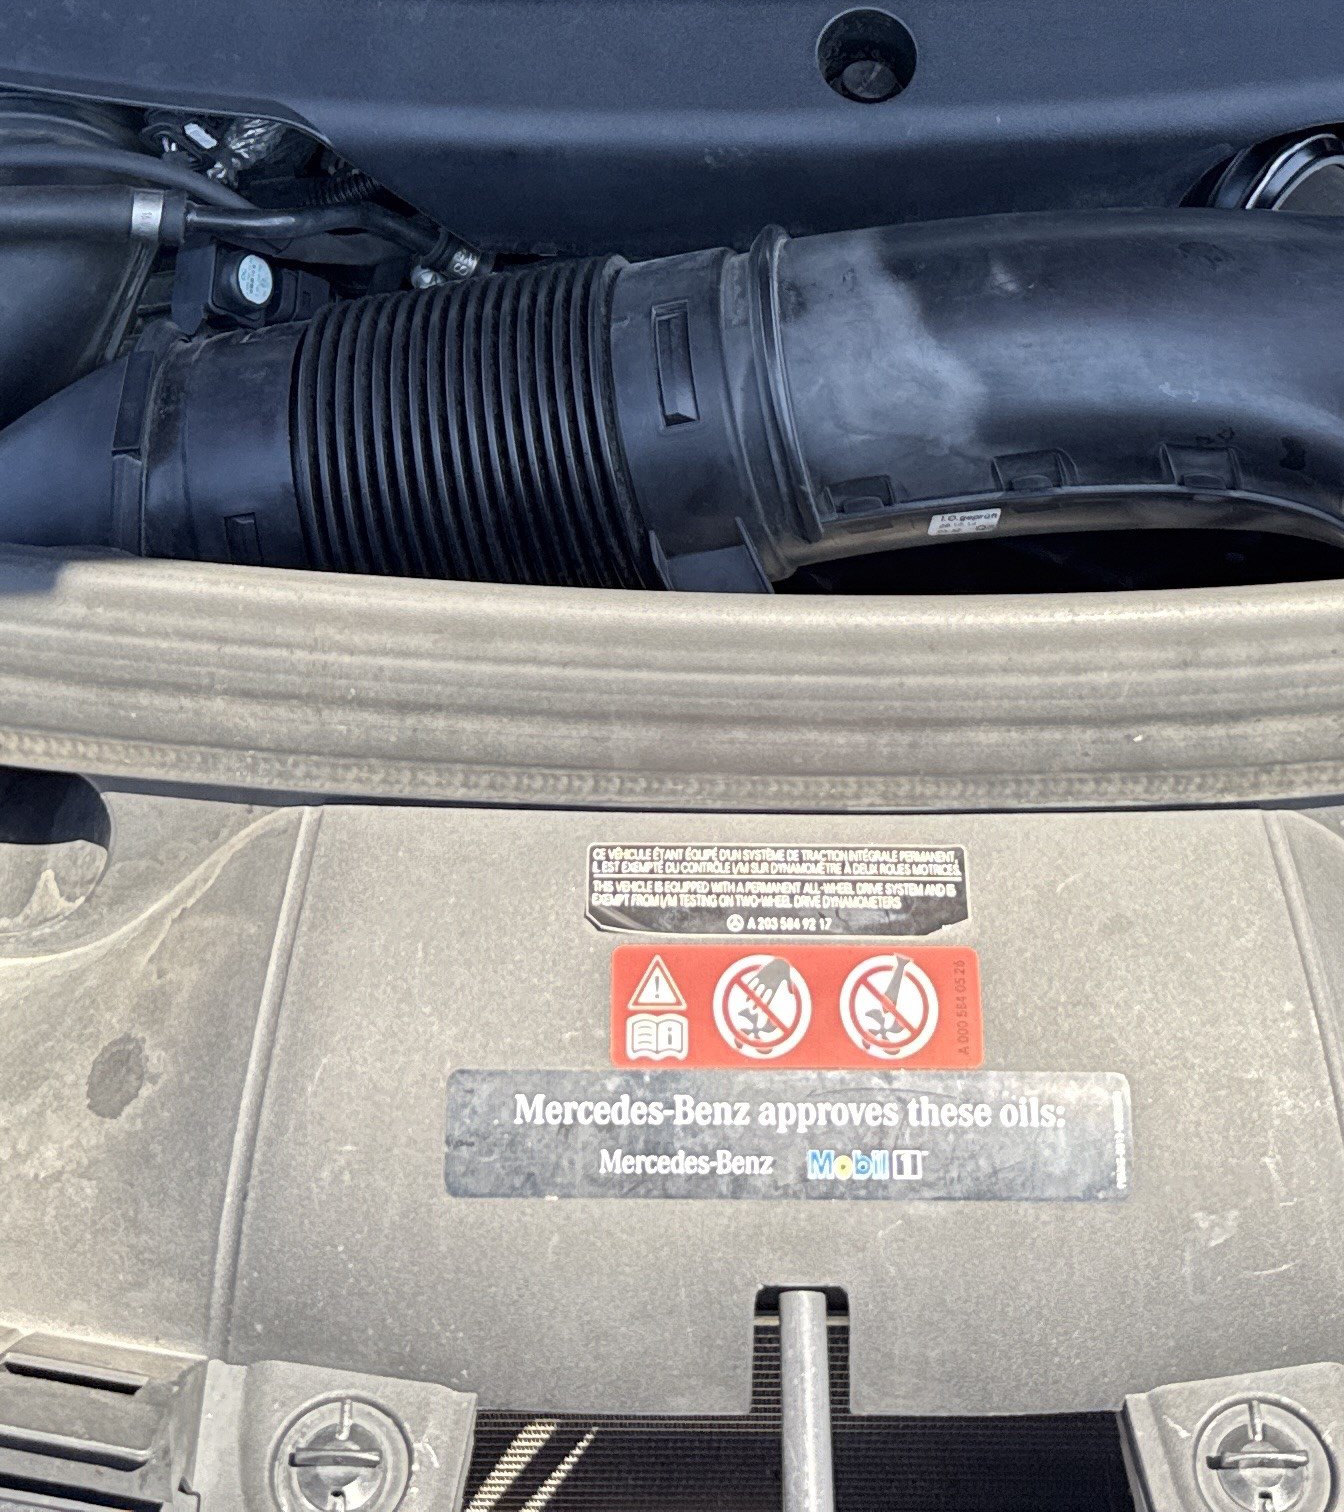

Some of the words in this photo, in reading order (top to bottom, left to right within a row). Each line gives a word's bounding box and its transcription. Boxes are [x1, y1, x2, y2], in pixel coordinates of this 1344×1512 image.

[592, 848, 607, 860] CE
[786, 850, 800, 861] DE
[801, 850, 847, 861] TRACTION
[601, 861, 620, 873] EST
[665, 861, 680, 873] DU
[750, 862, 769, 874] SUR
[593, 880, 614, 892] THIS
[615, 880, 653, 893] VEHICLE
[665, 881, 709, 894] EQUIPPED
[710, 881, 736, 894] WITH
[736, 882, 745, 894] A
[745, 882, 801, 895] PERMANENT
[802, 882, 855, 896] ALL-WHEEL
[856, 883, 884, 896] DRIVE
[885, 883, 924, 897] SYSTEM
[925, 884, 945, 897] AND
[592, 893, 630, 906] EXEMPT
[630, 893, 659, 907] FROM
[679, 894, 718, 907] TESTING
[718, 894, 735, 908] ON
[735, 895, 793, 908] TWO-WHEEL
[794, 895, 821, 908] DRIVE
[822, 896, 903, 909] DYNAMOMETERS
[746, 916, 756, 929] A
[757, 917, 779, 930] 203
[801, 918, 816, 931] 92
[819, 918, 833, 931] 17
[956, 1046, 970, 1056] A
[513, 1093, 751, 1126] Mercedes-Benz
[757, 1100, 900, 1134] approves
[906, 1095, 993, 1127] these
[999, 1095, 1067, 1128] oils:
[599, 1148, 774, 1176] Mercedes-Benz
[807, 1149, 890, 1180] Mobil
